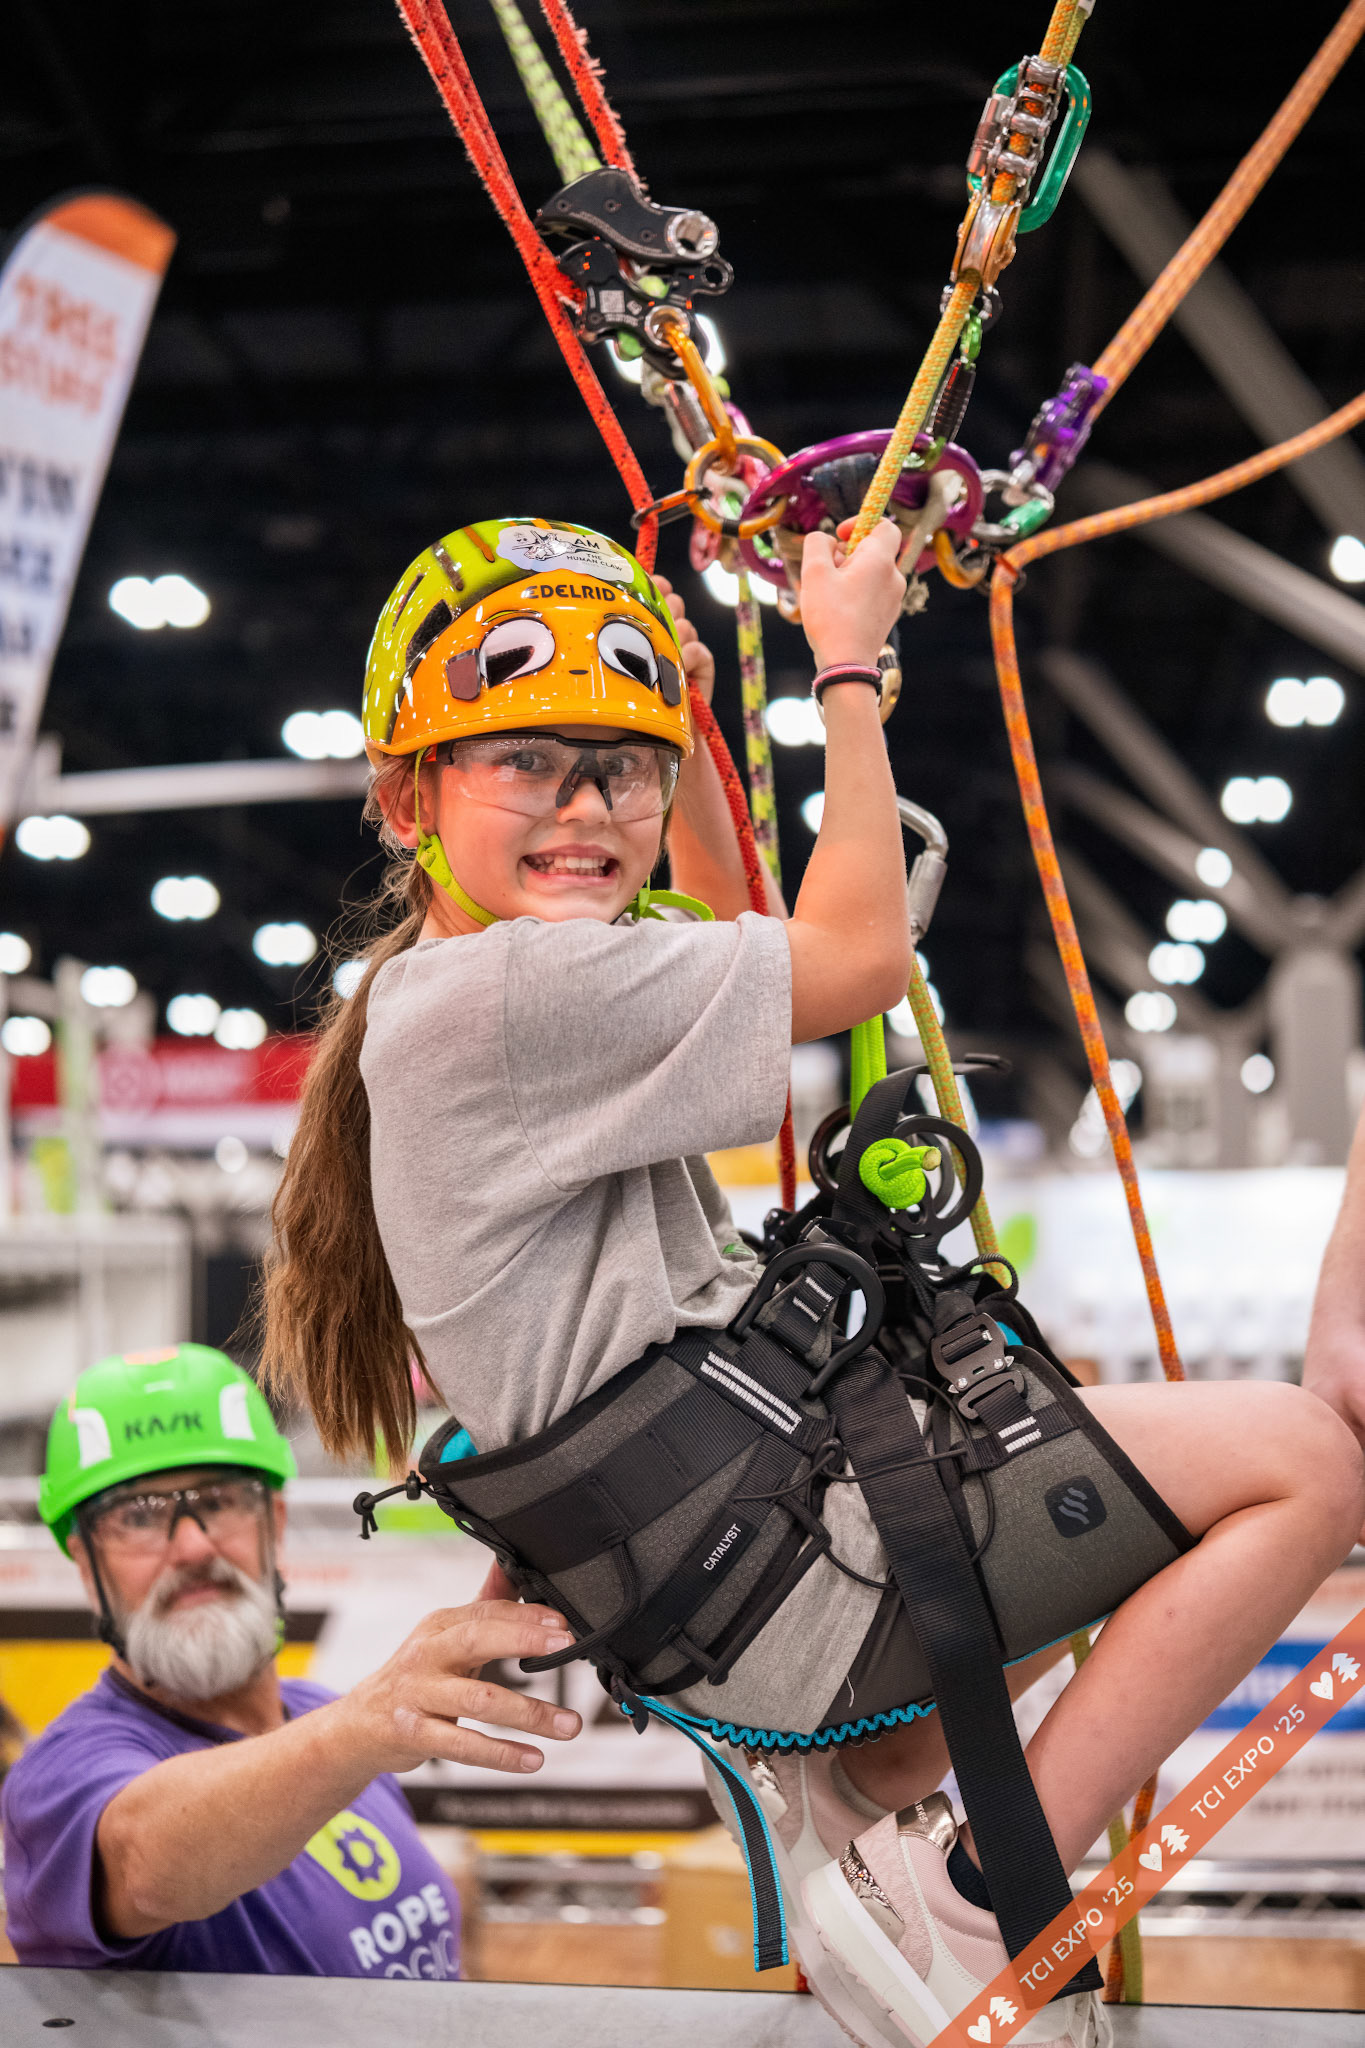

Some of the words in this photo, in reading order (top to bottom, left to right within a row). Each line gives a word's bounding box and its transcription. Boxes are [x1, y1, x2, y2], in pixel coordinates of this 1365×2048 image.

[574, 538, 600, 550] AM
[566, 555, 598, 564] HUMAN
[600, 561, 623, 572] CLAW
[587, 553, 602, 561] THE
[523, 584, 616, 602] EDELRID
[703, 1523, 742, 1571] CATALYST
[349, 1883, 450, 1971] ROPE
